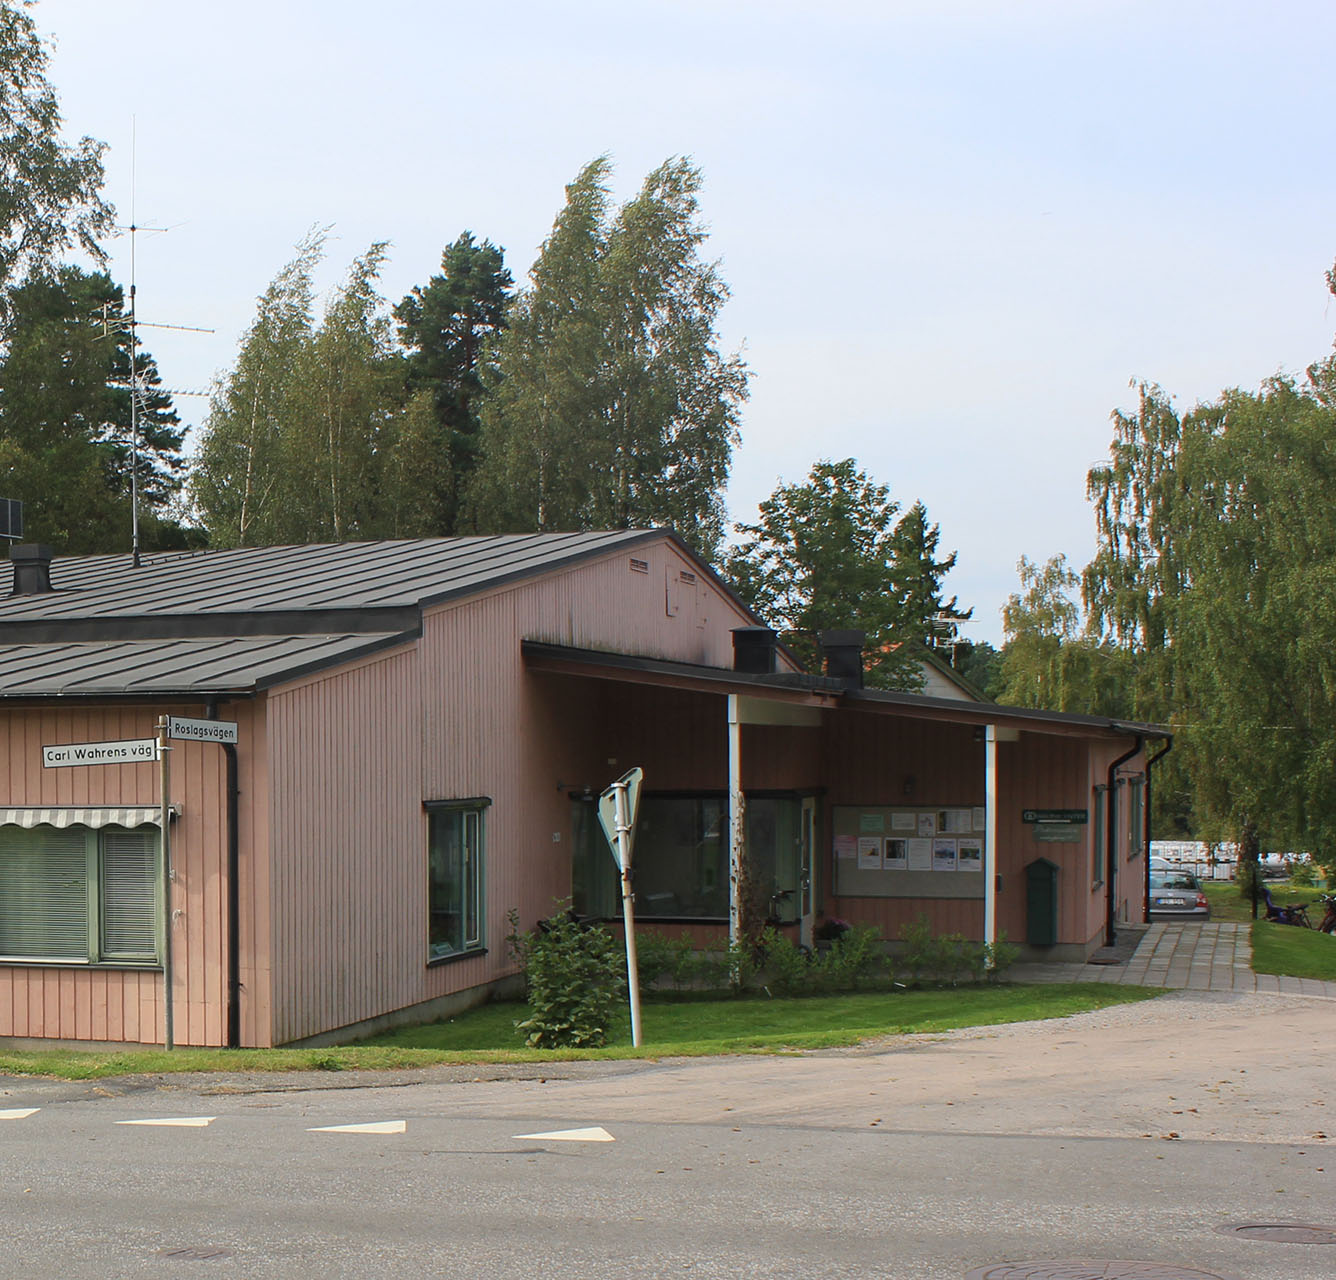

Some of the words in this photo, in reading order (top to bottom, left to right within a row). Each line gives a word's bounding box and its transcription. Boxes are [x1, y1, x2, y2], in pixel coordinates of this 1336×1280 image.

[175, 723, 234, 739] Roslagsvägen
[47, 749, 70, 761] Carl
[74, 747, 127, 760] Wahrens
[131, 744, 152, 758] väg
